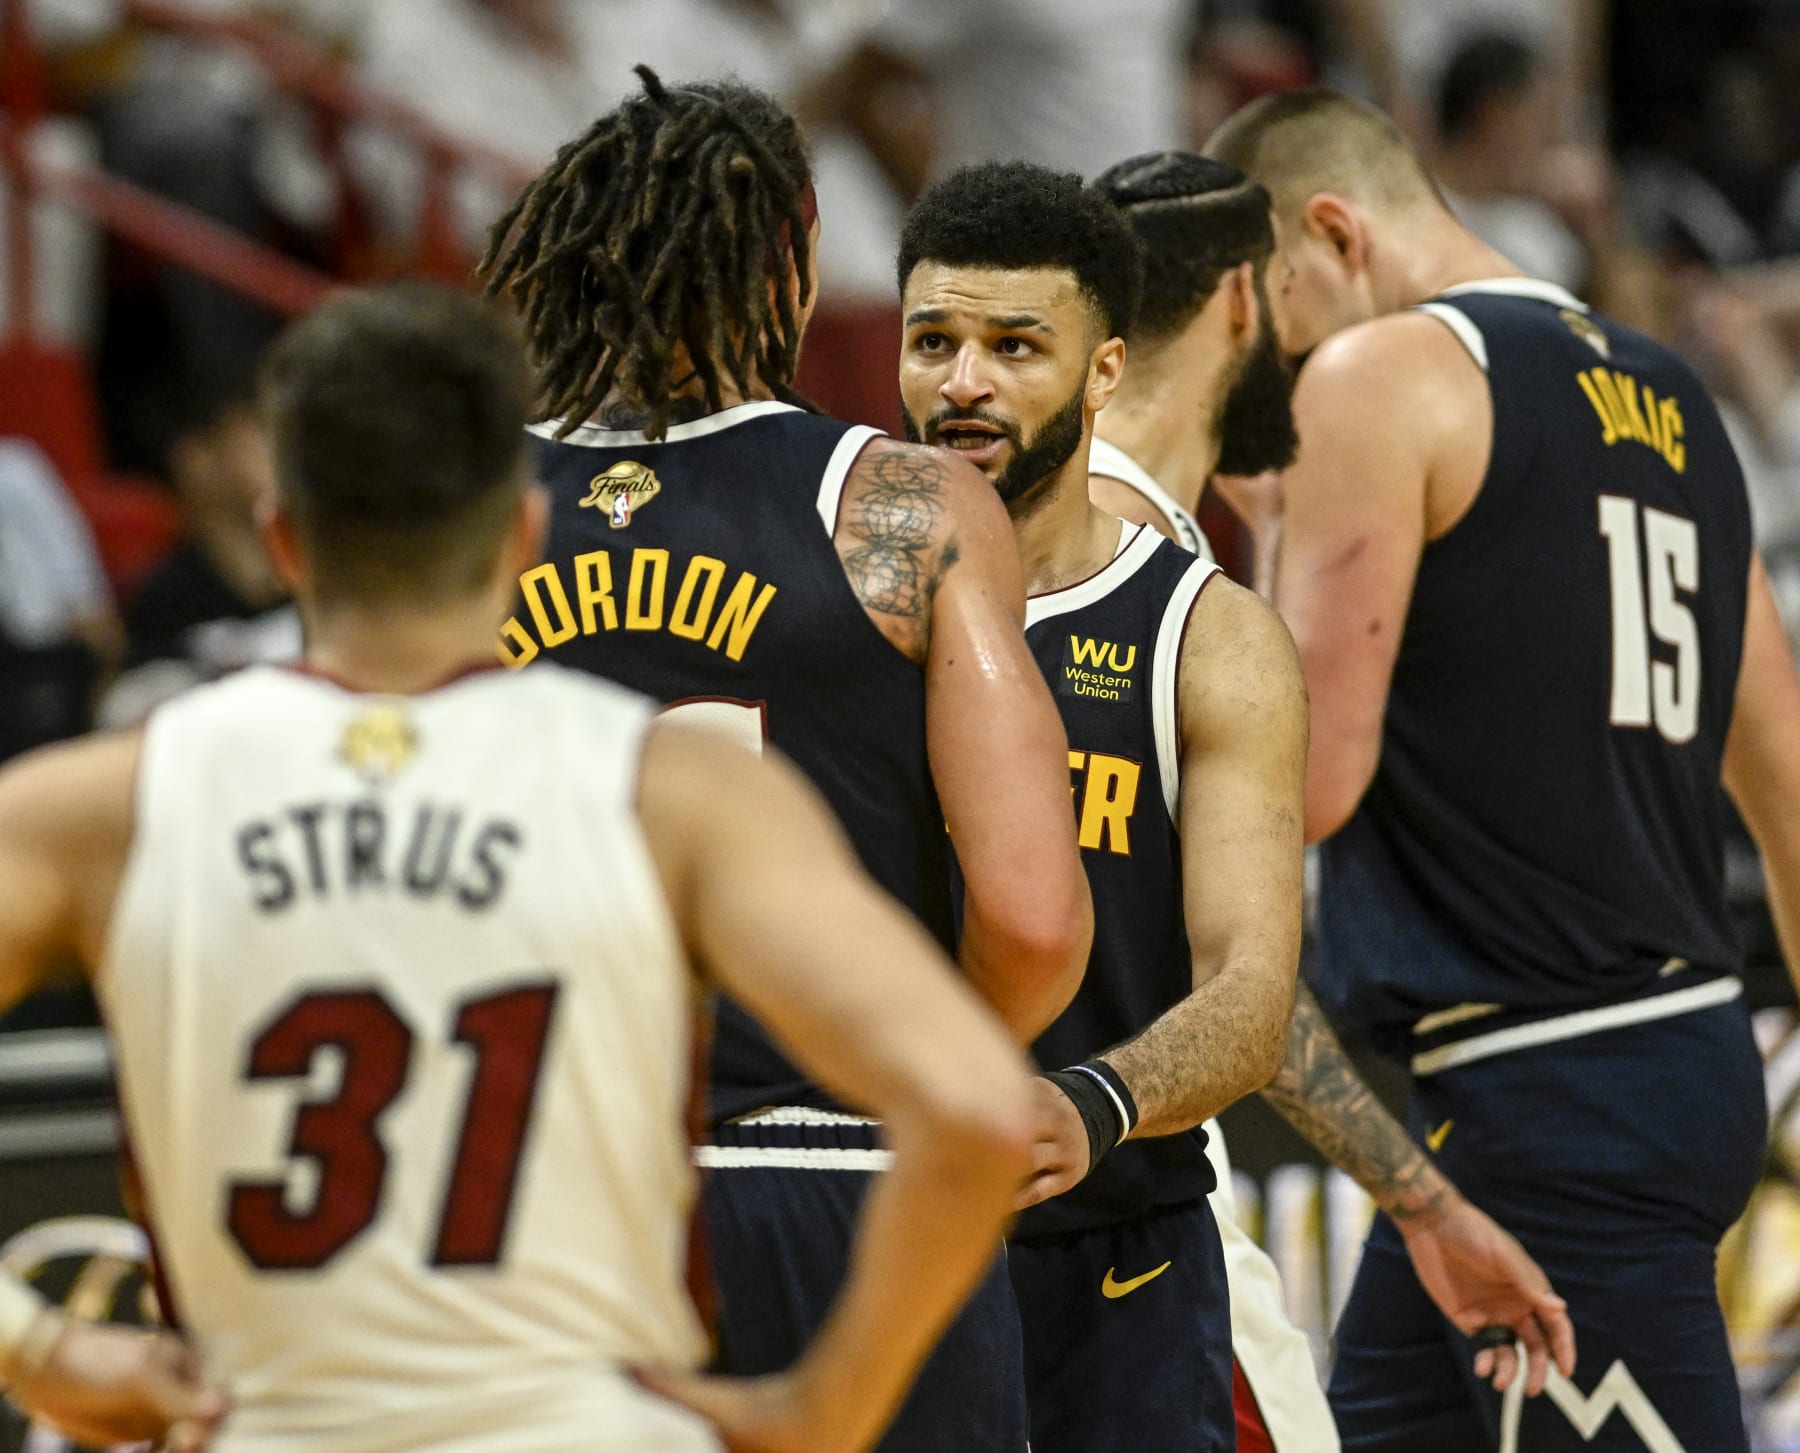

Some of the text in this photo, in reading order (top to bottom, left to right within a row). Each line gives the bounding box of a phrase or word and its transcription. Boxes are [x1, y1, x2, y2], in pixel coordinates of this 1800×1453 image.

[587, 472, 657, 503] Finals
[1598, 493, 1701, 744] 15
[1070, 634, 1137, 672] WU
[1065, 666, 1132, 689] Western
[1074, 681, 1119, 700] Union
[235, 797, 523, 914] STRUS
[224, 982, 560, 1272] 31
